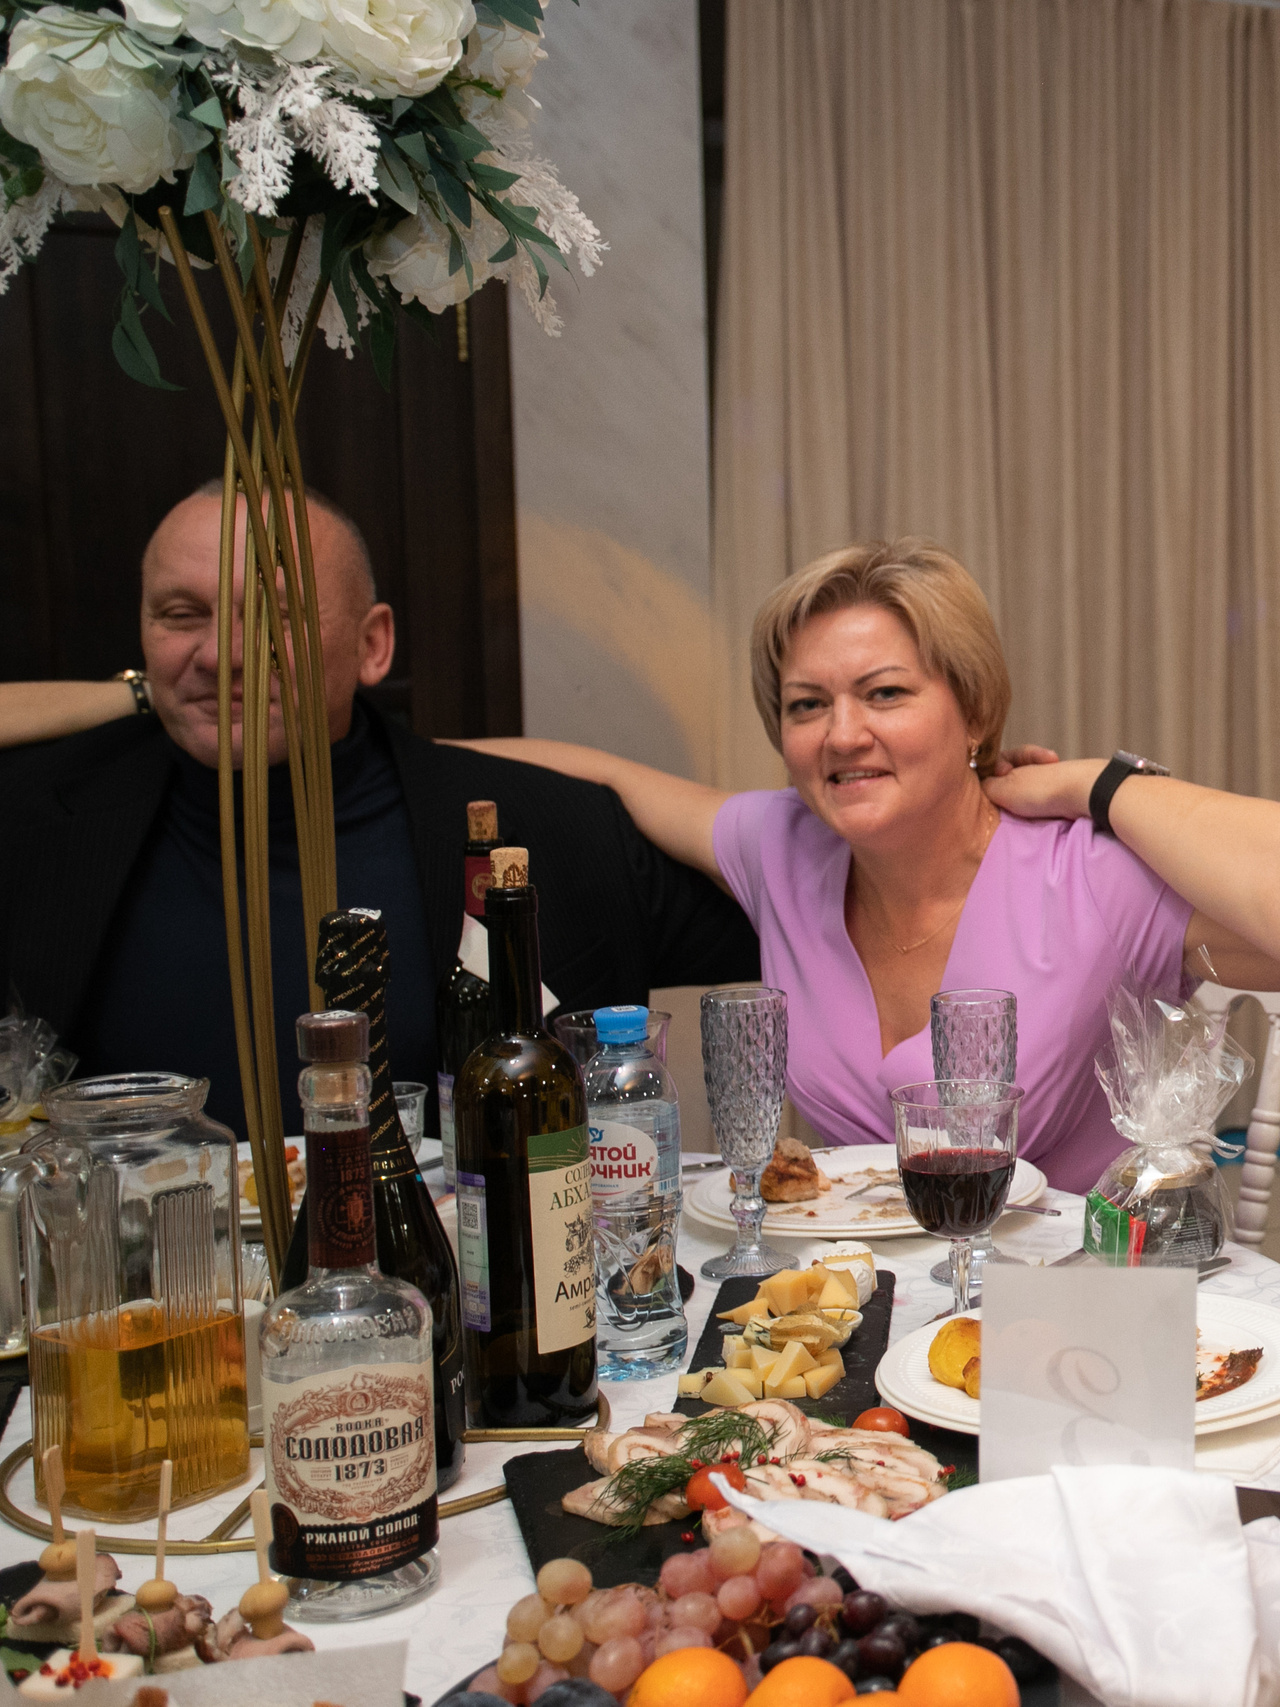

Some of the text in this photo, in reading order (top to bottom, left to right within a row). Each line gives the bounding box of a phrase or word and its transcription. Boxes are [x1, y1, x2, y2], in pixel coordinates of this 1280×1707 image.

[285, 1415, 425, 1460] СОЛОДОВАЯ
[336, 1417, 383, 1433] ВОДКА
[335, 1458, 386, 1482] 1873
[305, 1526, 370, 1545] РЖАНОЙ
[375, 1513, 418, 1537] СОЛОД
